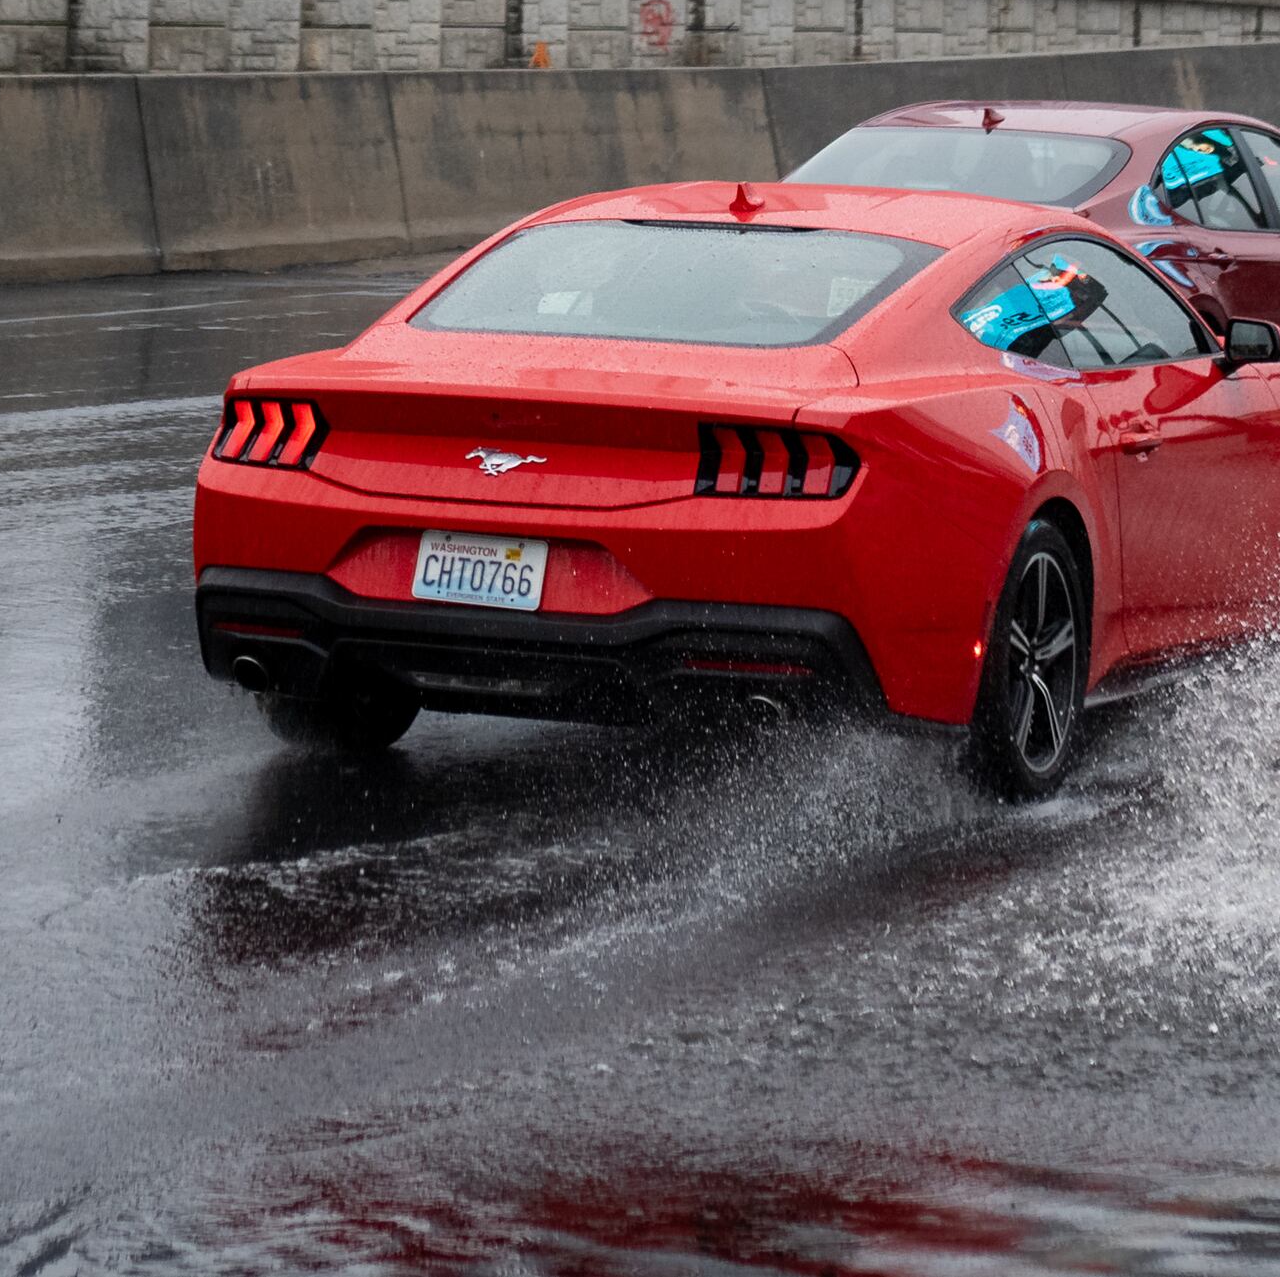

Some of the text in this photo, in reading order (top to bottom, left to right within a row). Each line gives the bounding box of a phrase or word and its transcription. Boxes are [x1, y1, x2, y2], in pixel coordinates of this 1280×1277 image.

[431, 543, 497, 557] WASHINGTON
[422, 554, 533, 597] CHT0766
[446, 591, 483, 601] EVERGREEN
